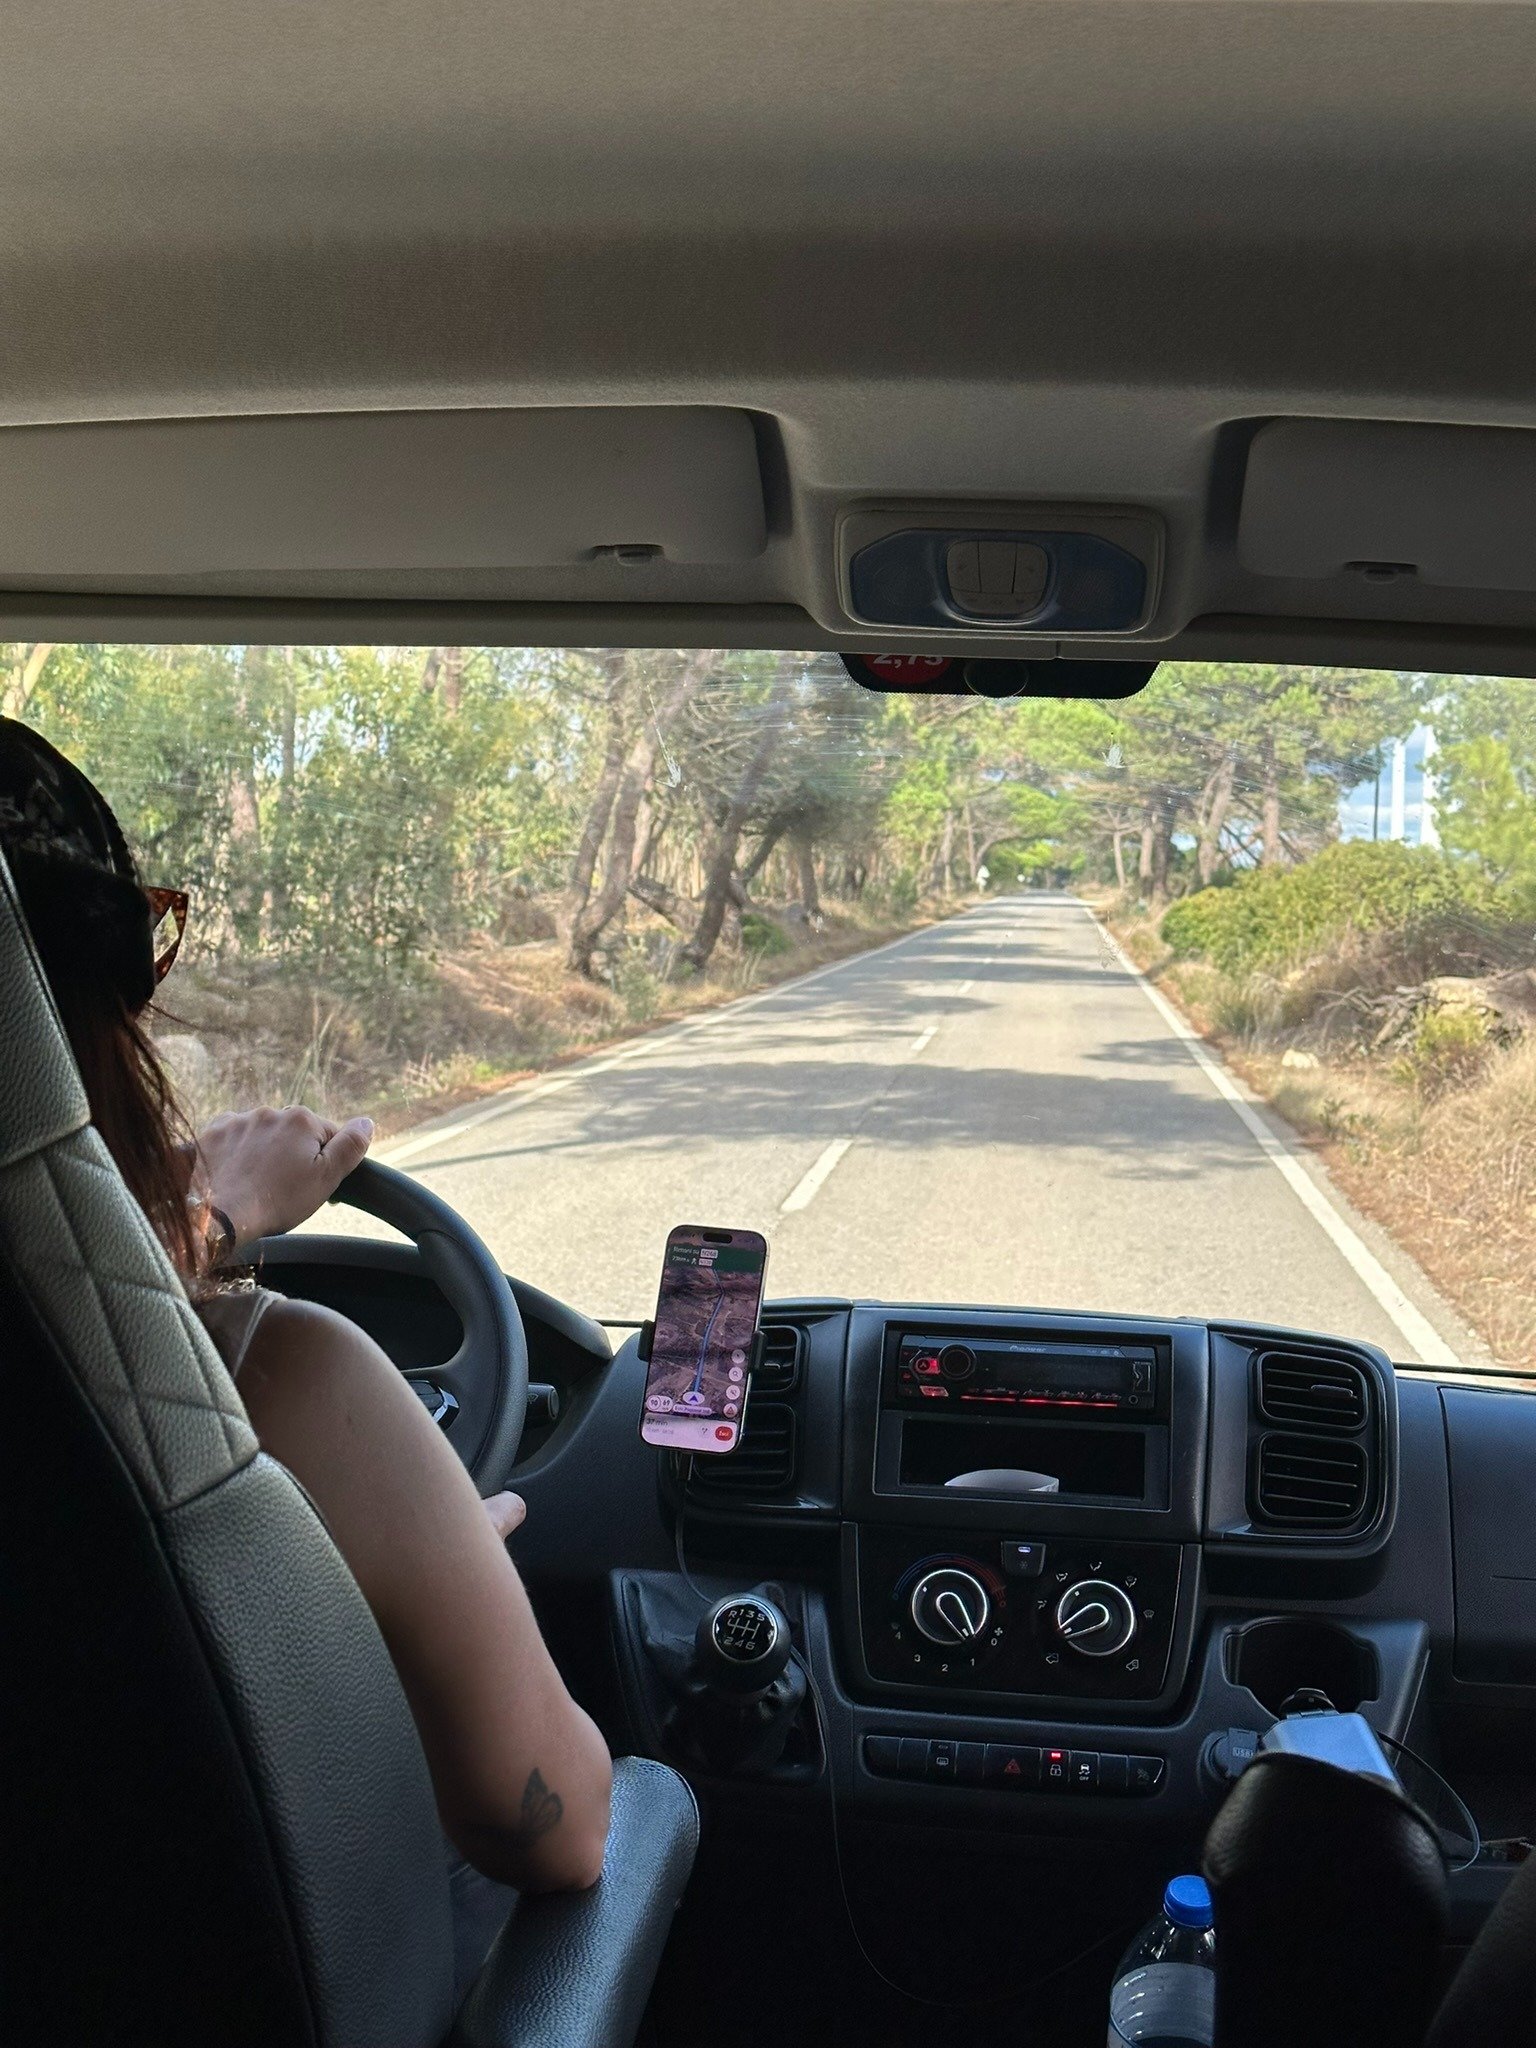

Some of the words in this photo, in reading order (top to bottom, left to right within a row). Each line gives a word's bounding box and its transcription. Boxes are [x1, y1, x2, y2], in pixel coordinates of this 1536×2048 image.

[728, 1610, 737, 1618] R
[740, 1608, 744, 1616] 1
[746, 1610, 755, 1618] 3
[723, 1636, 734, 1645] 2
[734, 1640, 744, 1648] 4
[745, 1641, 756, 1650] 6
[991, 1638, 998, 1646] 0
[914, 1654, 921, 1662] 3
[970, 1658, 975, 1666] 1
[942, 1664, 948, 1672] 2
